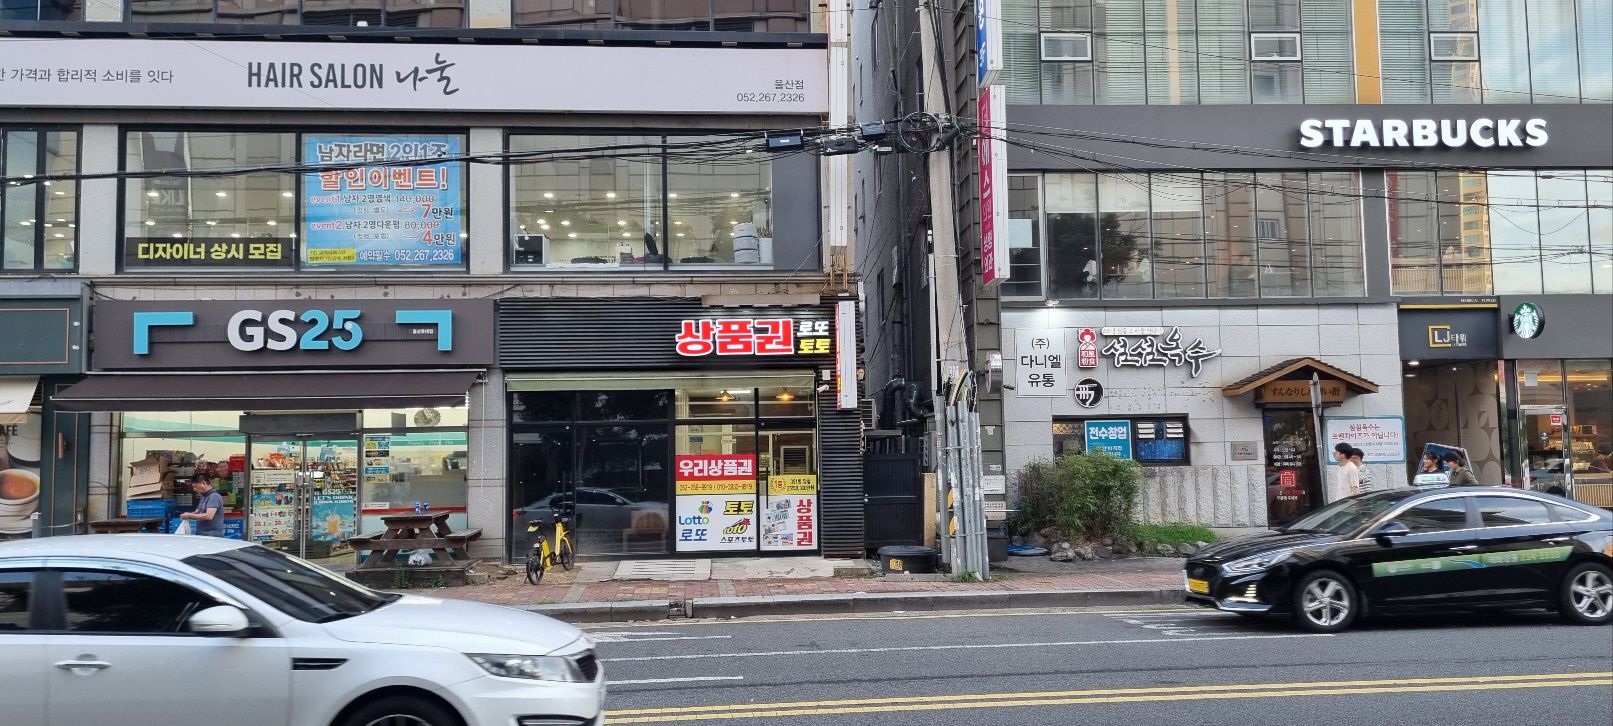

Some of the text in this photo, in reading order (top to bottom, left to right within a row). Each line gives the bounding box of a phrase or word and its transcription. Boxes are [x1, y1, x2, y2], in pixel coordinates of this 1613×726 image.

[10, 68, 52, 83] 가격과
[57, 68, 97, 83] 합리적
[101, 69, 143, 83] 소비를
[147, 69, 174, 83] 잇다
[247, 61, 304, 88] HAIR
[309, 62, 384, 89] SALON
[774, 79, 804, 90] 울산점
[736, 92, 805, 103] 052.267.2326
[1299, 118, 1550, 148] STARBUCKS
[317, 143, 386, 163] 남자라면
[319, 167, 448, 191] 할인이벤트!
[344, 193, 359, 204] 남자
[421, 203, 454, 219] 7만원
[345, 220, 361, 231] 남자
[422, 230, 456, 246] 4만원
[137, 242, 282, 260] 디자이너 상시 모집
[394, 248, 455, 262] 052.267.2326
[226, 309, 364, 352] GS25
[675, 319, 830, 357] 상품권 로또
[797, 338, 831, 354] 토토
[1031, 337, 1050, 350] (주)
[1020, 354, 1062, 369] 다니엘
[1027, 373, 1056, 388] 유통
[1089, 426, 1127, 440] 전수창업
[679, 459, 753, 477] 우리상품권
[722, 500, 754, 515] 토토
[678, 515, 710, 526] Lotto
[796, 499, 813, 547] 상품권
[679, 528, 708, 542] 로또
